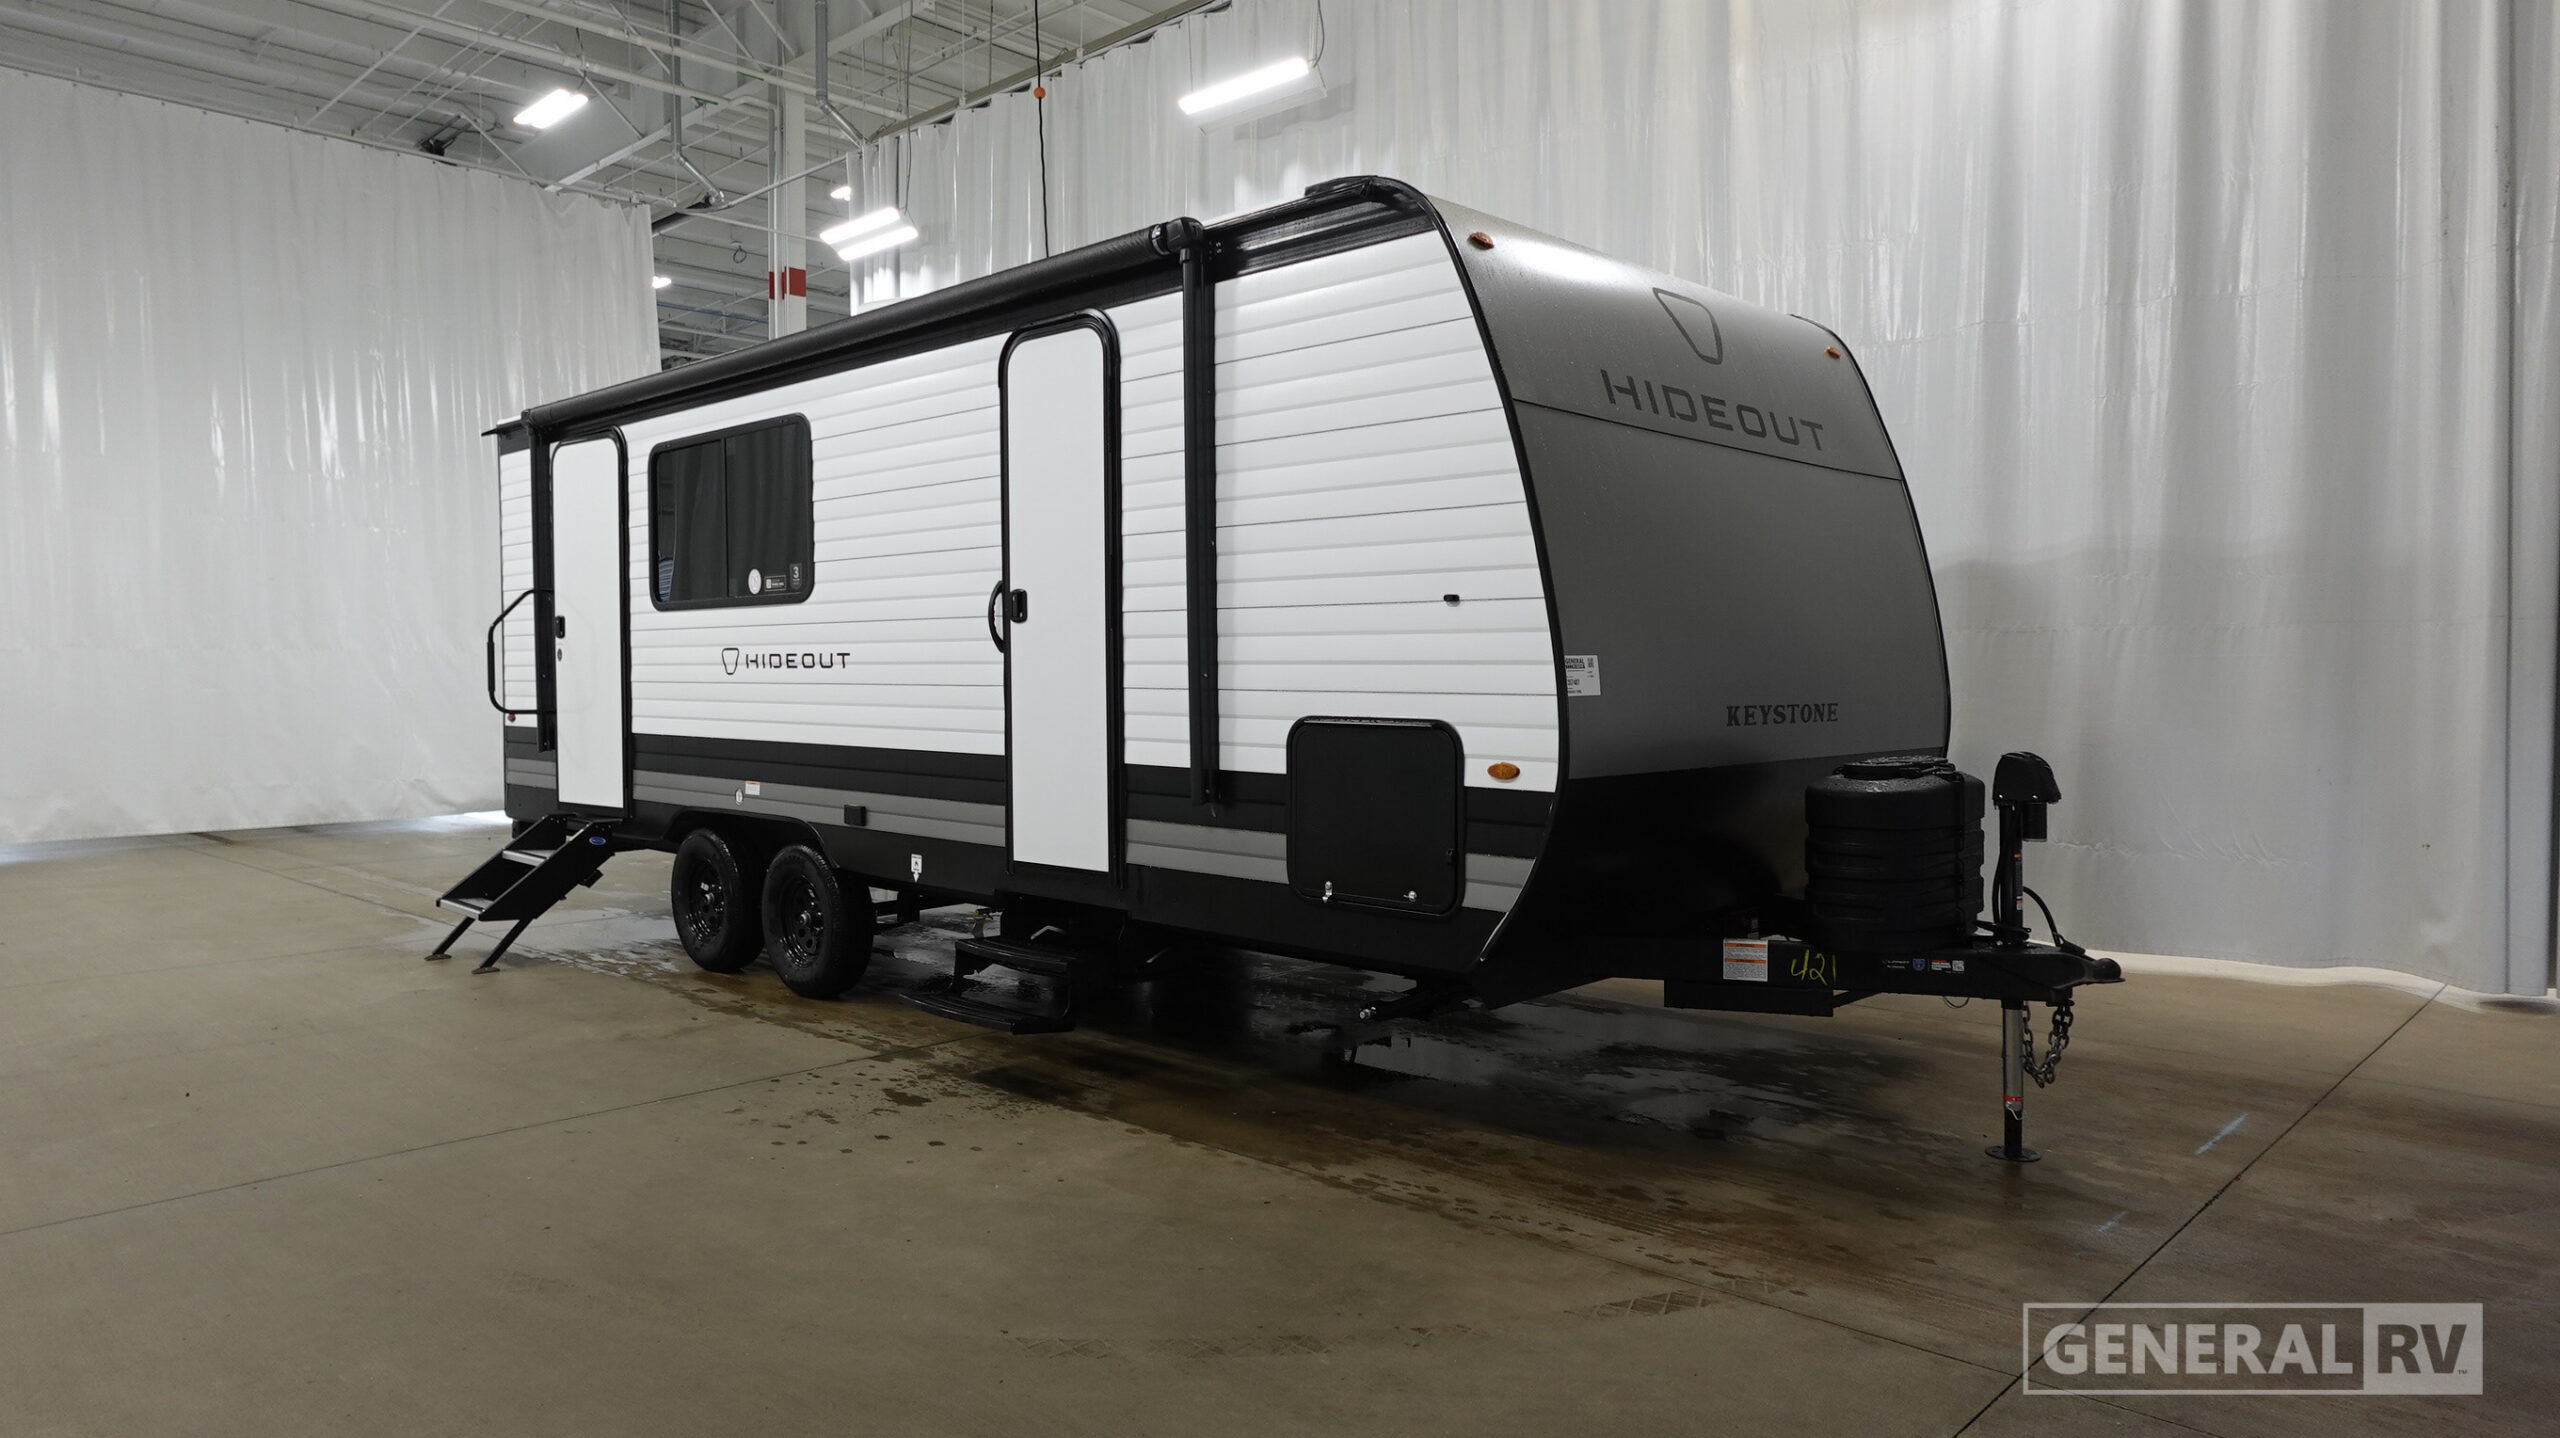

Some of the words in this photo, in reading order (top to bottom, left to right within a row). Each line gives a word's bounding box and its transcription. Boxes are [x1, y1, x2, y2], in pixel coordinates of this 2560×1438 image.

[1600, 368, 1824, 451] HIDEOUT
[792, 566, 800, 579] 3
[746, 653, 851, 669] HIDEOUT
[1726, 703, 1839, 727] KEYSTONE
